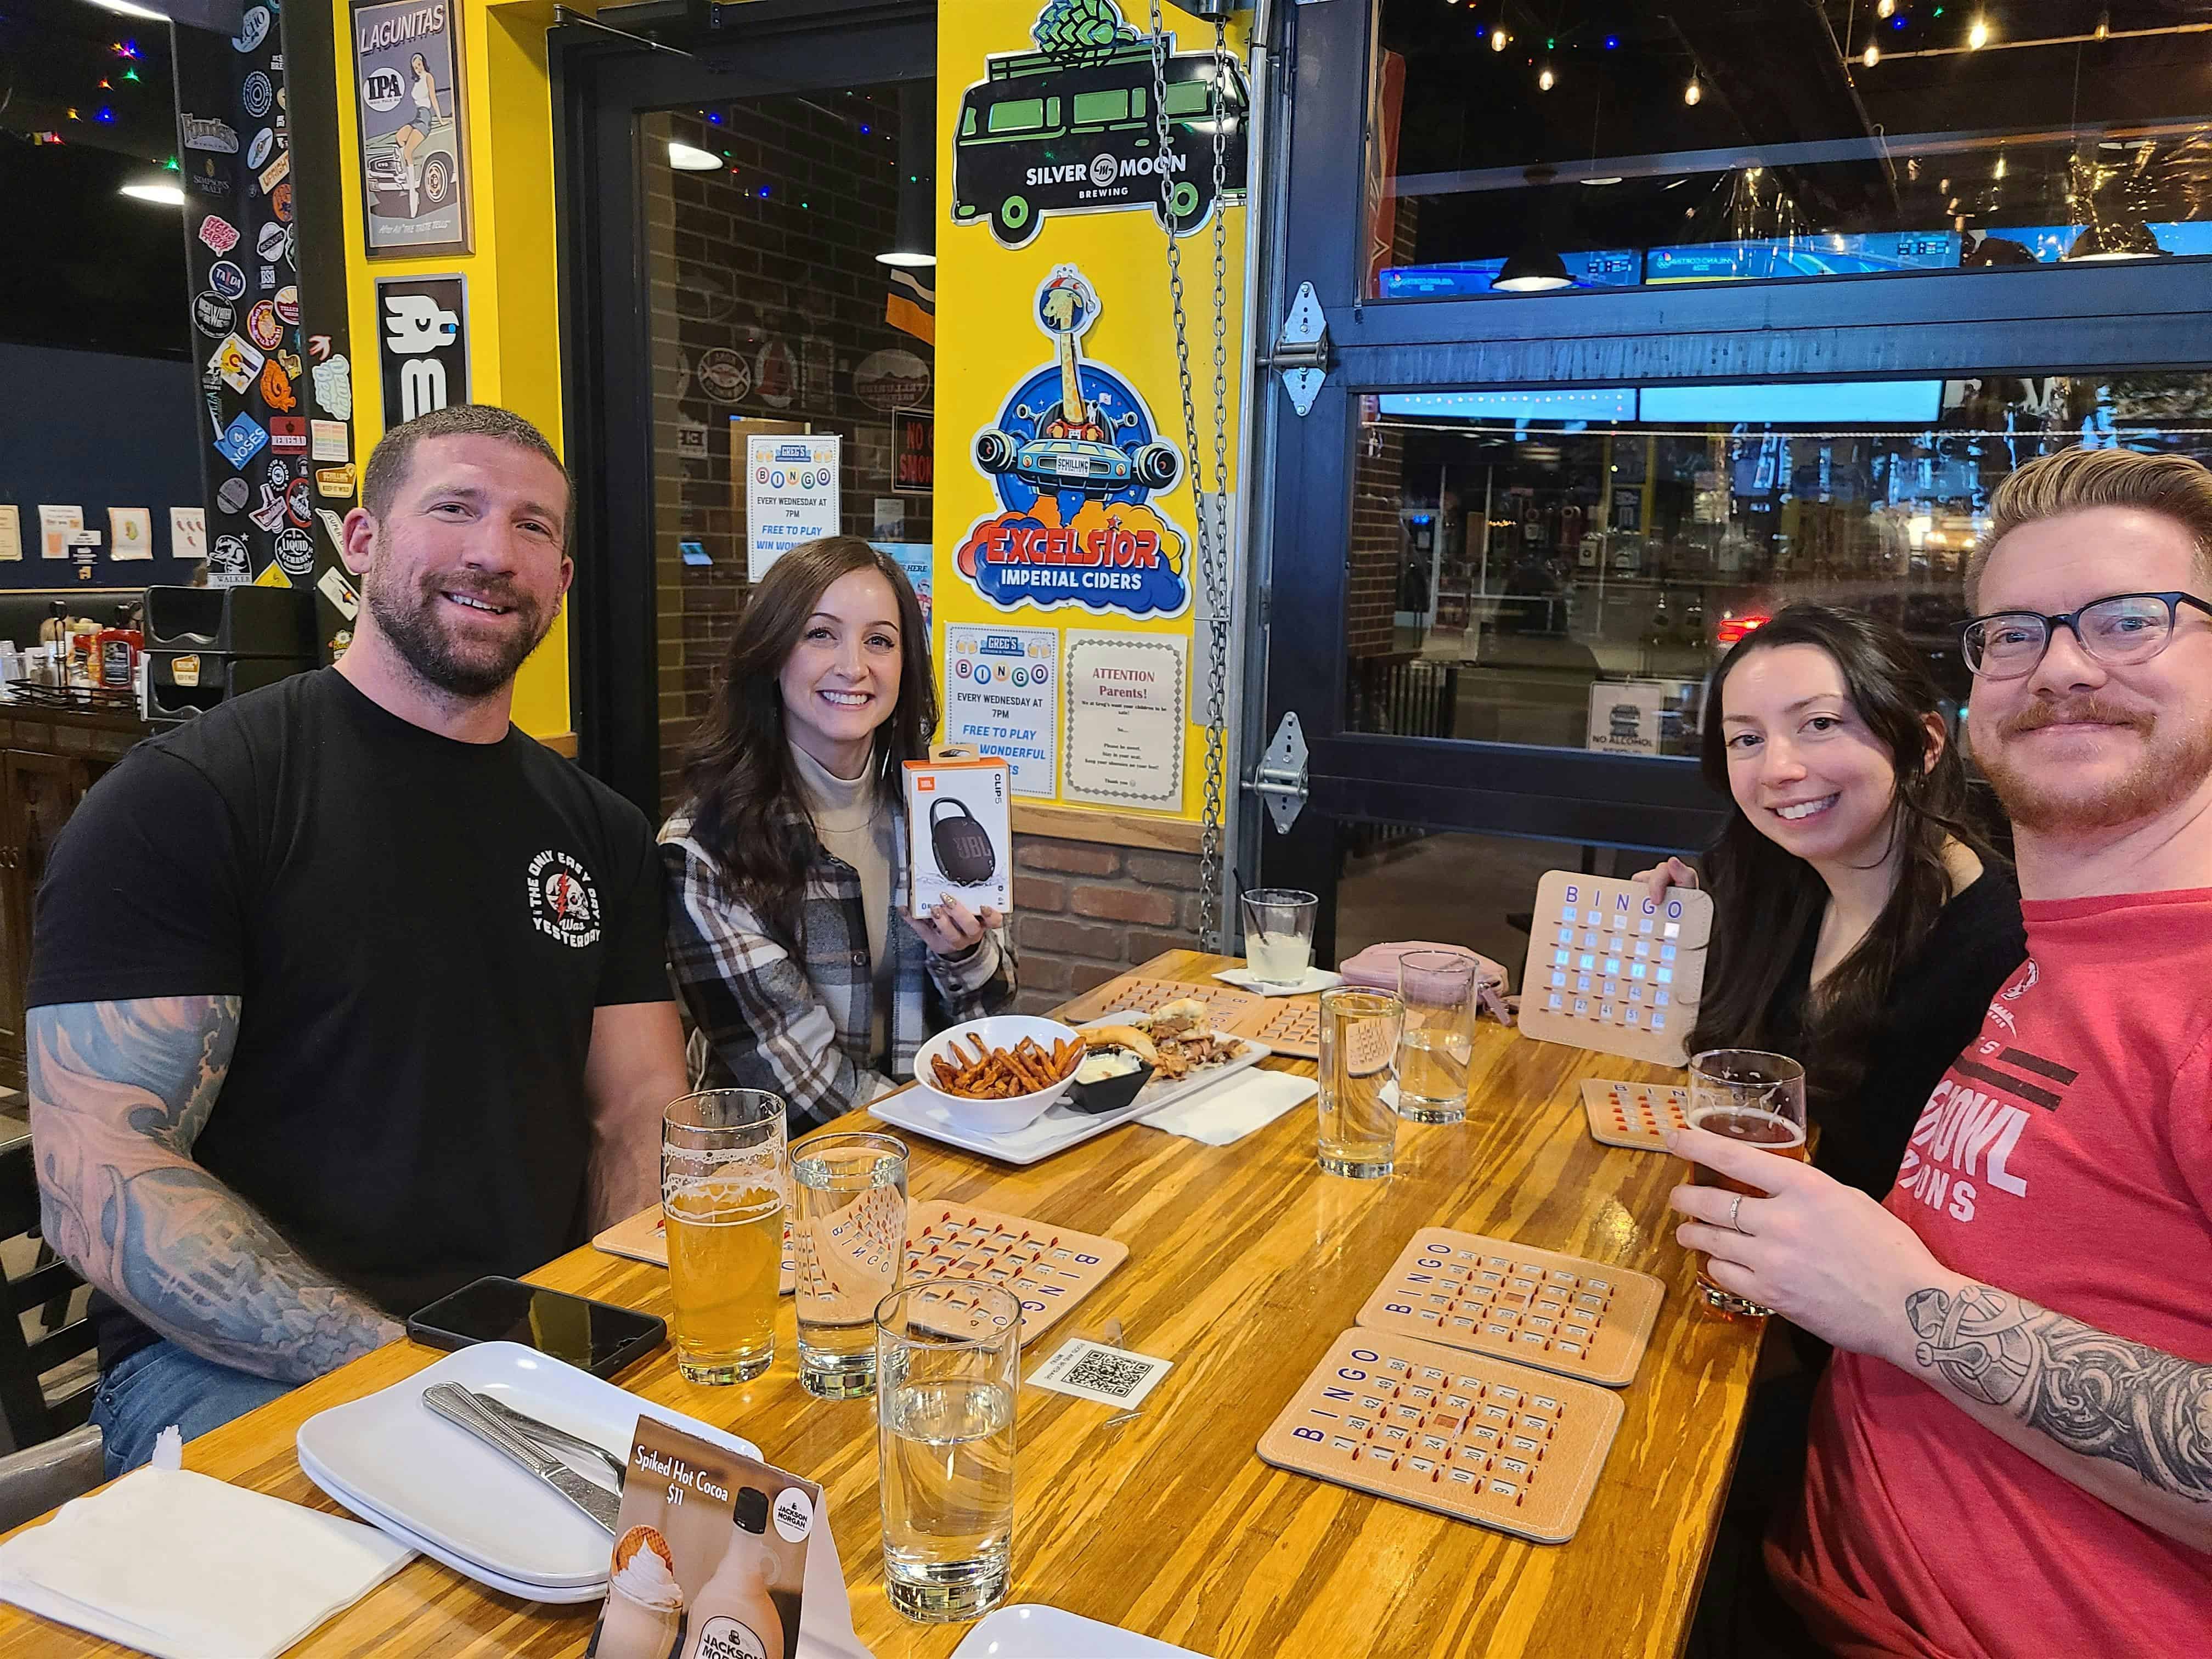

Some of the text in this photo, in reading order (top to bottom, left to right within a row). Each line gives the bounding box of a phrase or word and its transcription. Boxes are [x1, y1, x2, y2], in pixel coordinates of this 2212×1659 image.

[360, 4, 444, 54] LAGUNITAS
[367, 74, 402, 101] IPA
[1026, 154, 1187, 185] SILVER MOON
[1079, 187, 1129, 199] BREWING
[907, 421, 924, 449] NO
[781, 445, 805, 457] GREG'S
[900, 454, 933, 483] SMOK
[1058, 458, 1088, 470] SCHILLING
[759, 471, 827, 484] BINGO
[757, 496, 827, 506] EVERY WEDNESDAY AT
[786, 510, 800, 518] 7PM
[762, 524, 822, 536] FREE TO PLAY
[282, 538, 309, 551] LIQUID
[757, 540, 774, 550] WIN
[988, 528, 1160, 569] EXCELSIOR
[1001, 569, 1142, 590] IMPERIAL CIDERS
[989, 637, 1017, 650] GREG'S
[961, 663, 1043, 682] BINGO
[1093, 668, 1155, 682] ATTENTION
[1099, 685, 1148, 699] Parents!
[957, 693, 1043, 708] EVERY WEDNESDAY AT
[992, 709, 1009, 719] 7PM
[963, 725, 1036, 741] FREE TO PLAY
[1609, 736, 1652, 747] ALCOHOL
[980, 744, 1046, 760] WONDERFUL
[959, 836, 991, 859] JBL
[527, 850, 601, 920] THE ONLY EASY DAY
[1565, 885, 1683, 919] BINGO
[558, 918, 586, 930] Was
[532, 917, 601, 948] YESTERDAY
[1614, 1084, 1686, 1097] BIN
[1385, 1243, 1452, 1314] BINGO
[1292, 1349, 1379, 1443] BINGO
[635, 1445, 729, 1502] Spiked Hot Cocoa
[667, 1483, 684, 1506] $11
[777, 1505, 808, 1522] JACKSON
[777, 1511, 806, 1528] MORGAN
[703, 1634, 763, 1659] JACKSO
